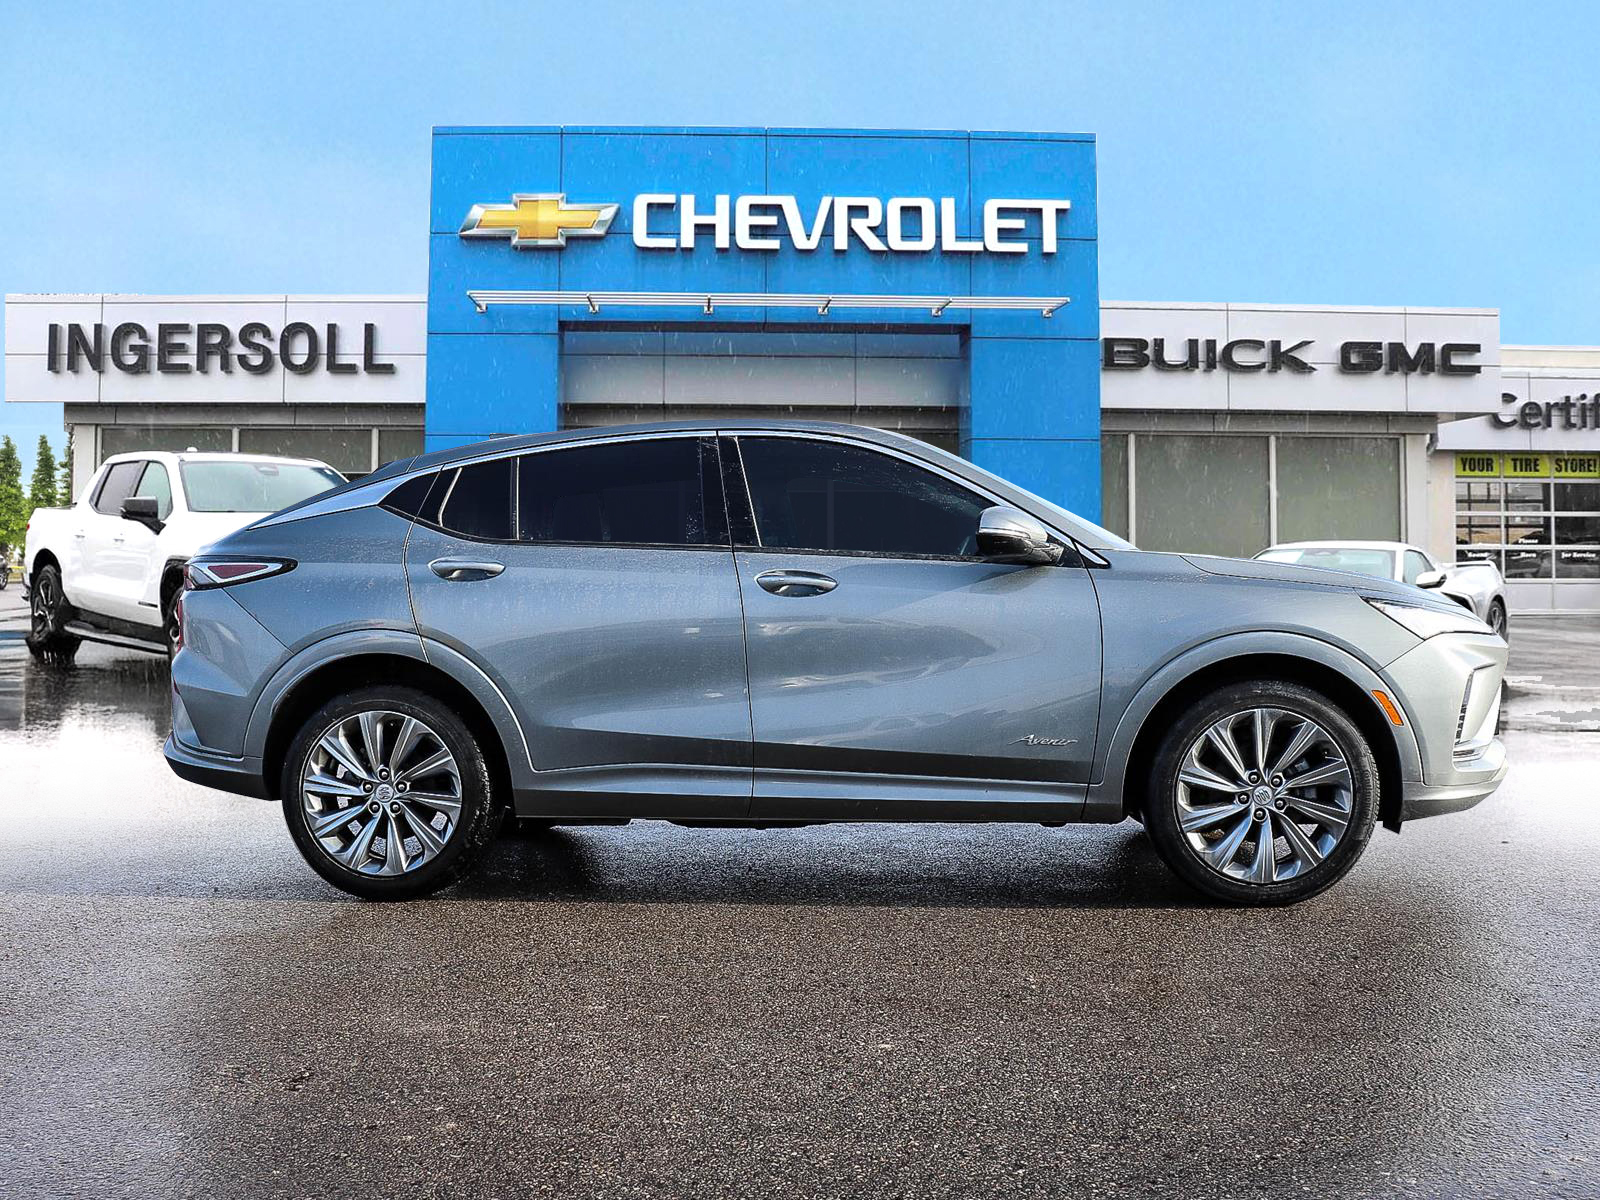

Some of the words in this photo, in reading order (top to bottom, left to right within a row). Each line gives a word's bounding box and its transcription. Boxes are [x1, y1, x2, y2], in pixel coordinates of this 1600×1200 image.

[632, 193, 1071, 254] CHEVROLET
[47, 322, 396, 374] INGERSOLL
[1102, 337, 1318, 372] BUICK
[1340, 340, 1482, 375] GMC
[1460, 457, 1494, 473] YOUR
[1511, 457, 1540, 473] TIRE
[1554, 457, 1597, 474] STORE!
